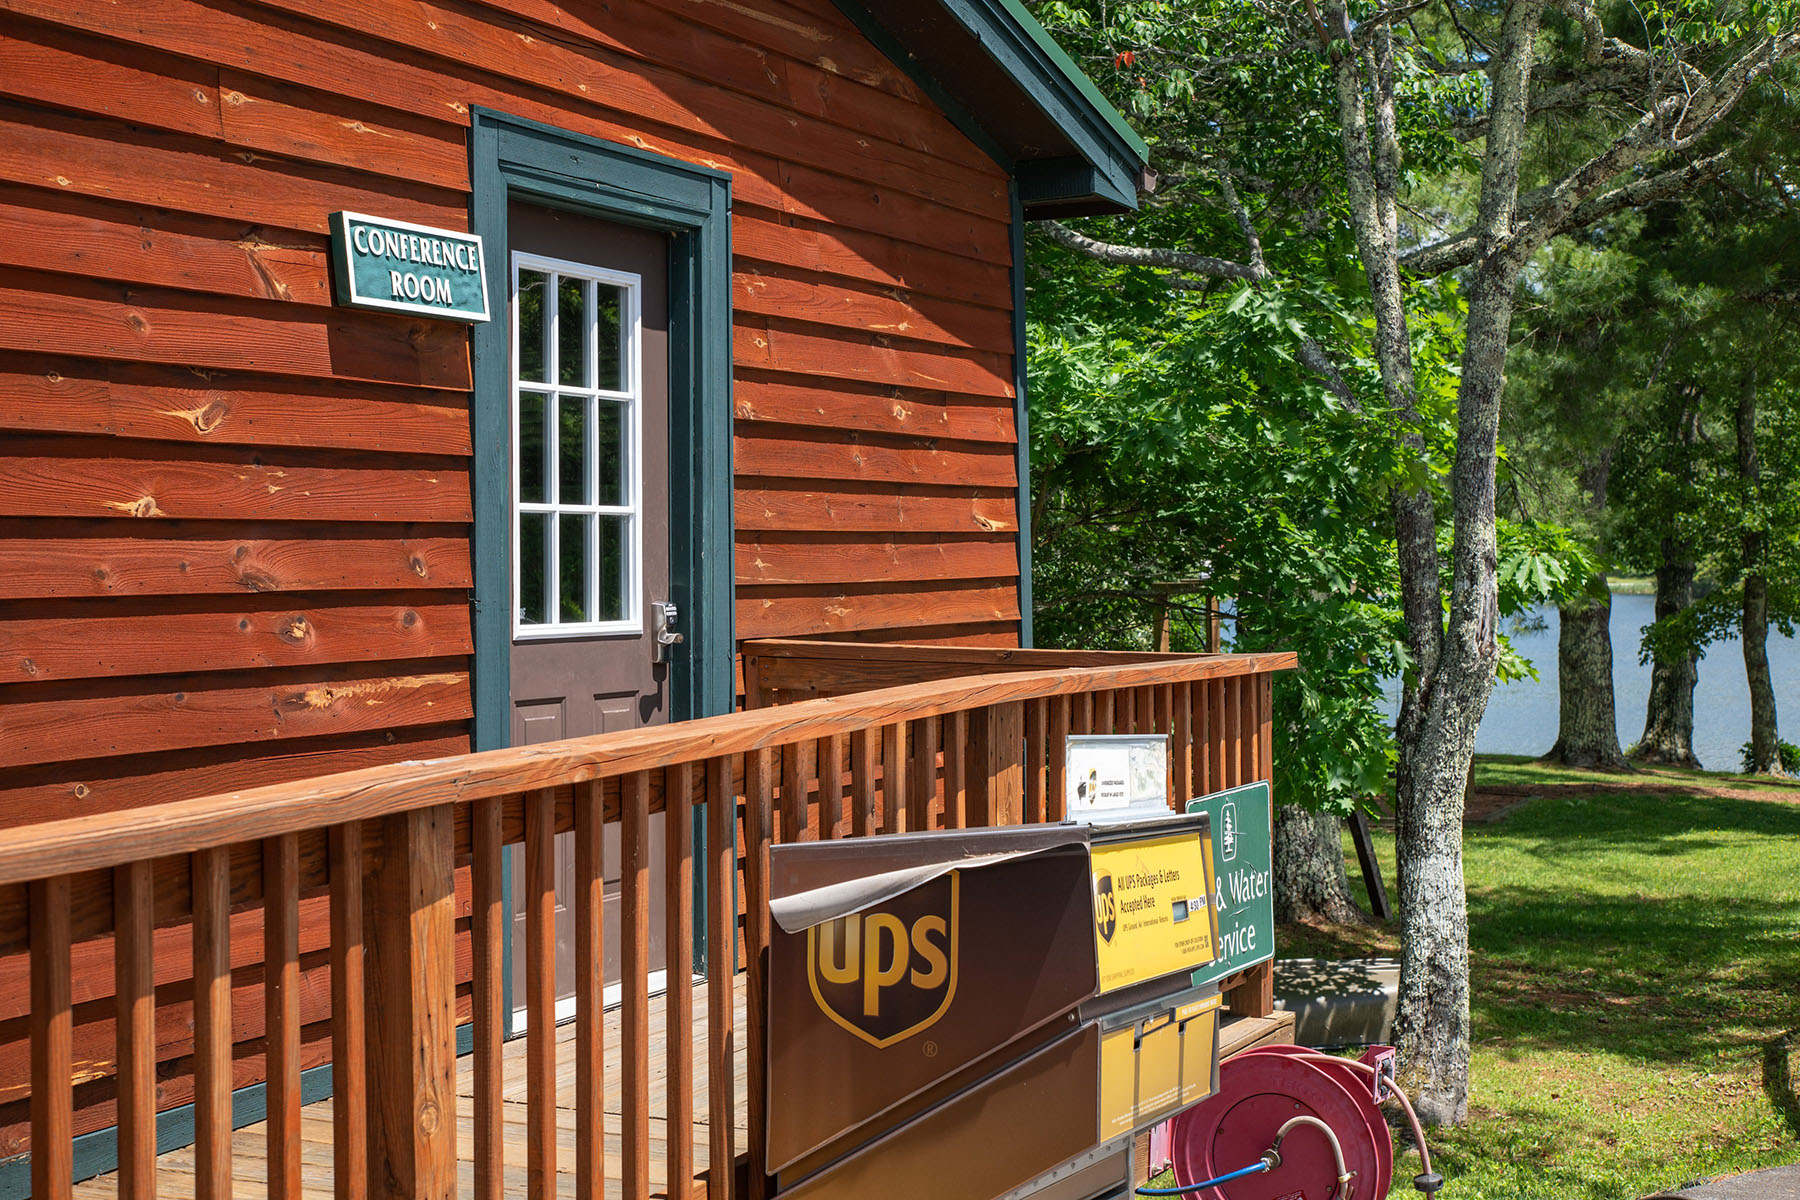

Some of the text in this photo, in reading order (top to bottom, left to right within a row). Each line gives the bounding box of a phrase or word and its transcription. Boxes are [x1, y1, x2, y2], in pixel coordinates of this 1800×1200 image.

[353, 226, 478, 272] CONFERENCE
[389, 270, 453, 304] ROOM
[1125, 874, 1136, 890] UPS
[1136, 872, 1159, 889] Packages
[1164, 869, 1180, 883] Letters
[1215, 868, 1269, 912] & Water
[1094, 891, 1115, 935] ups
[1120, 894, 1155, 915] Accepted Here
[818, 912, 948, 1017] ups
[1209, 921, 1257, 967] ervice
